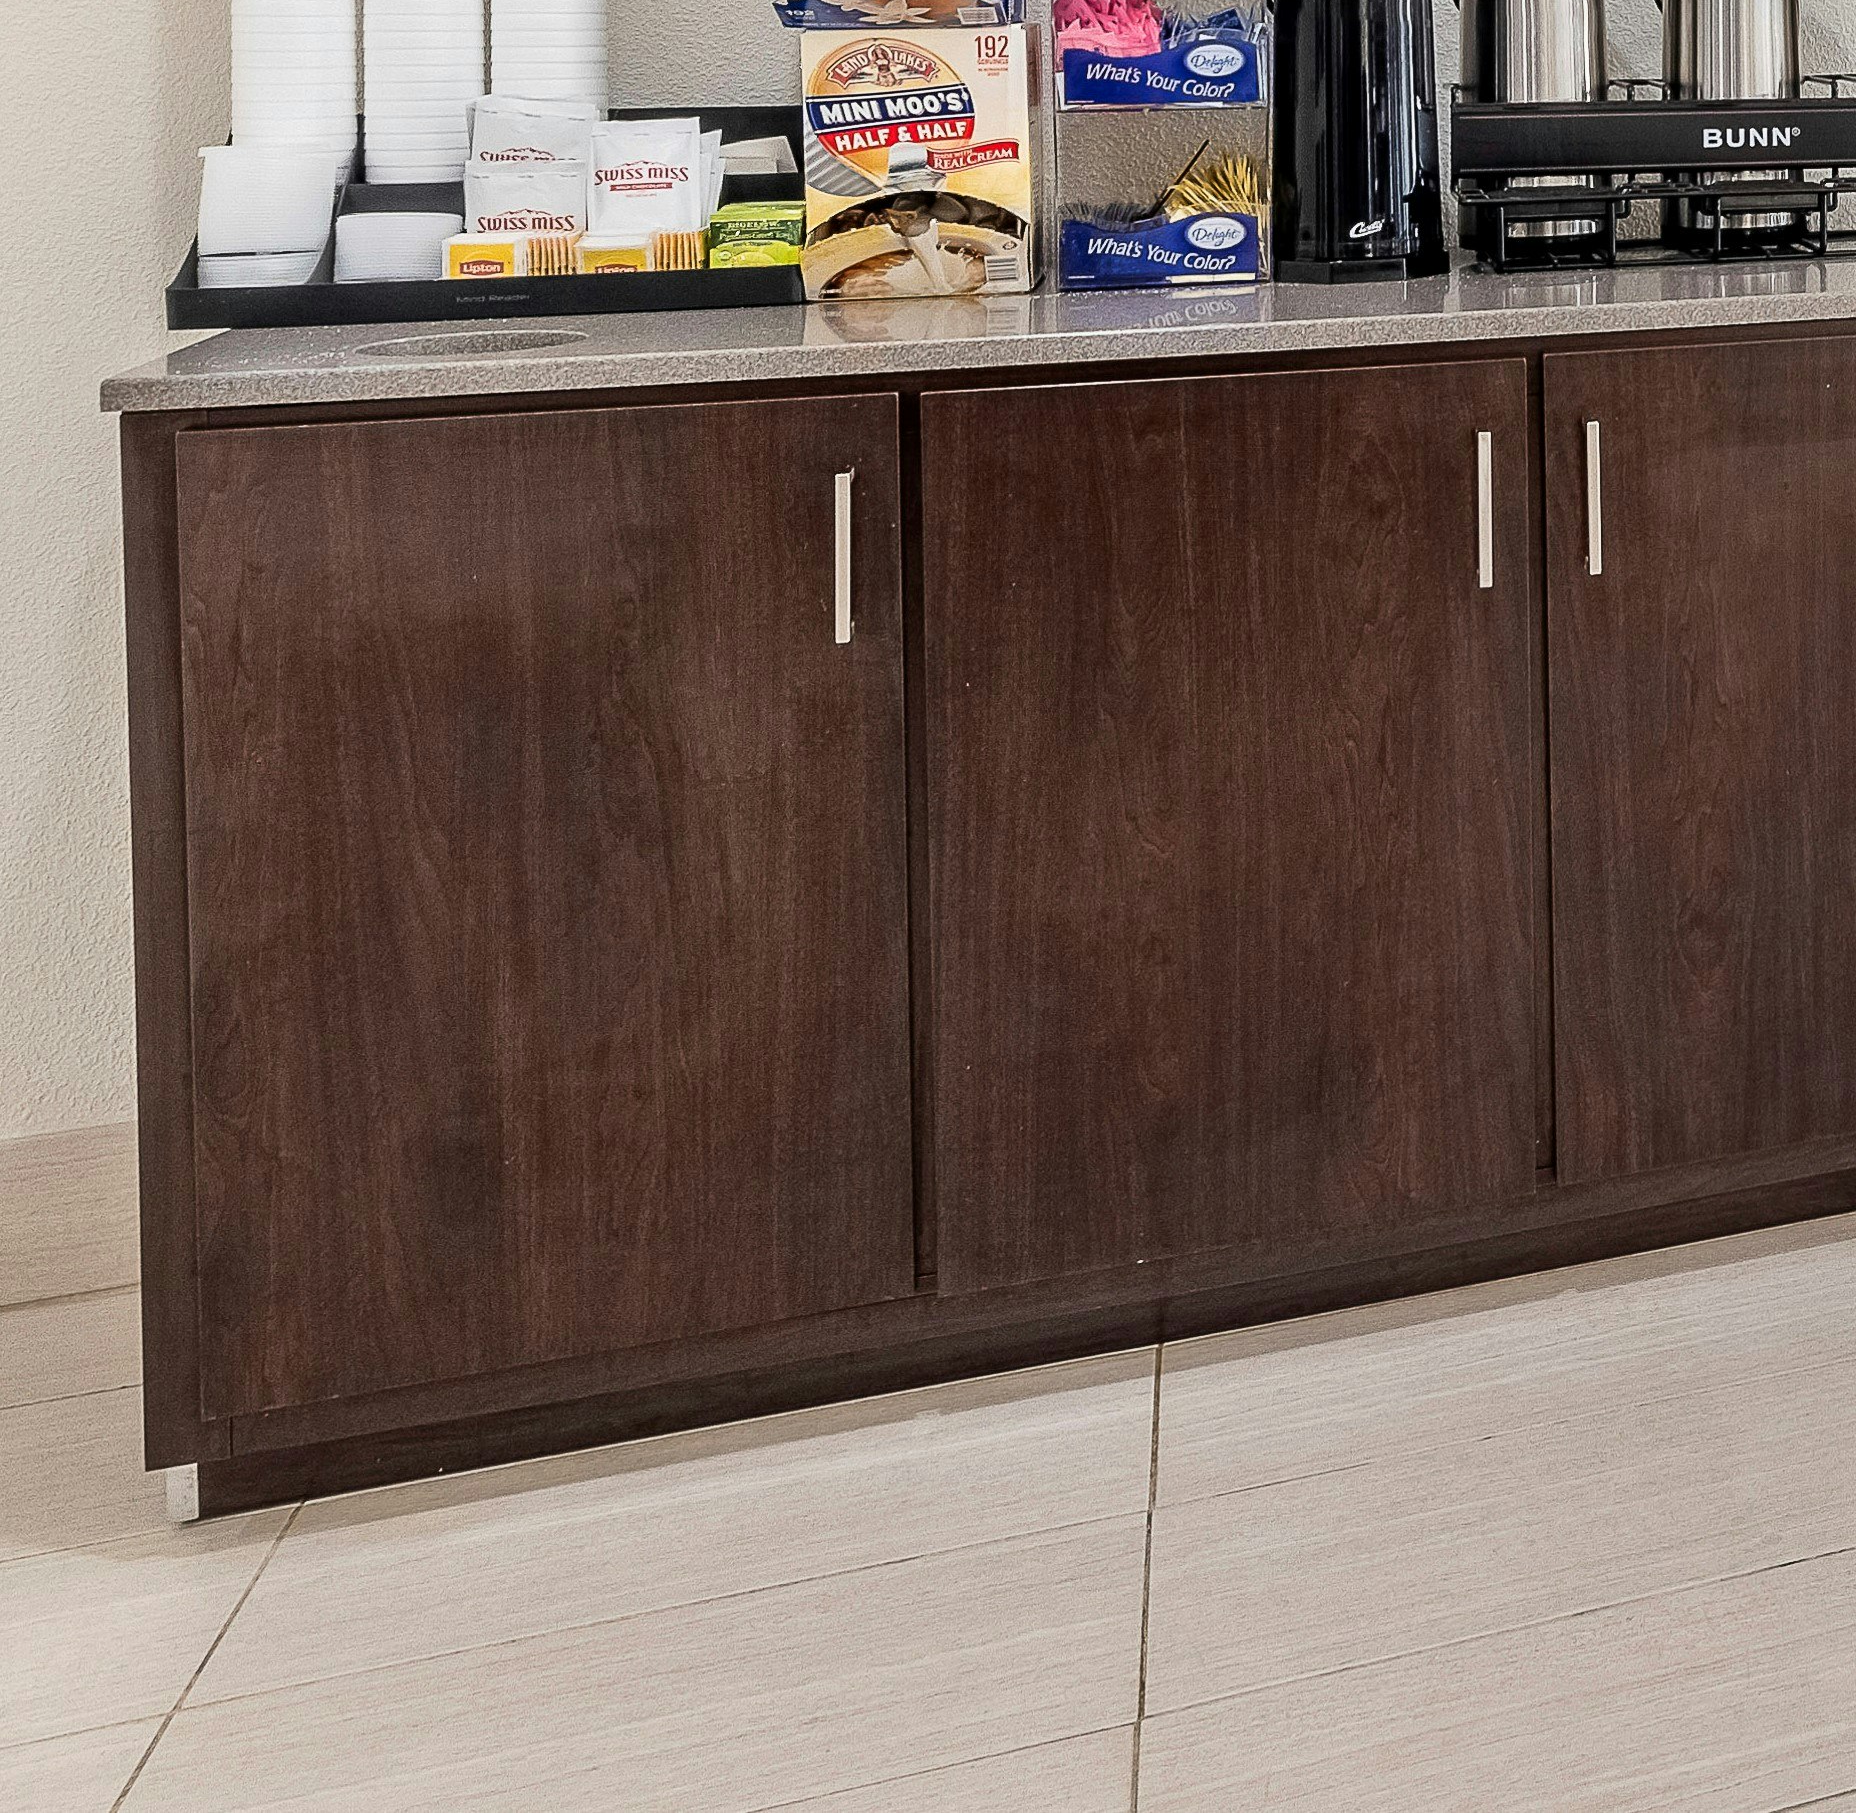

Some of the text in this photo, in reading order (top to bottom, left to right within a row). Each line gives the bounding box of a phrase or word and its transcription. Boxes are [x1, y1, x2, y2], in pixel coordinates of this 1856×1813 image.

[975, 35, 1009, 58] 192
[835, 53, 868, 76] LAND
[893, 51, 929, 71] LAKES
[1086, 63, 1235, 98] What's Your Color?
[819, 92, 963, 124] MINI MOO'S
[835, 121, 967, 152] HALF & HALF
[934, 148, 1013, 169] REAL CREAM
[1192, 228, 1241, 247] Delight
[1087, 238, 1236, 271] What's Your Color?
[462, 263, 501, 274] Lipton
